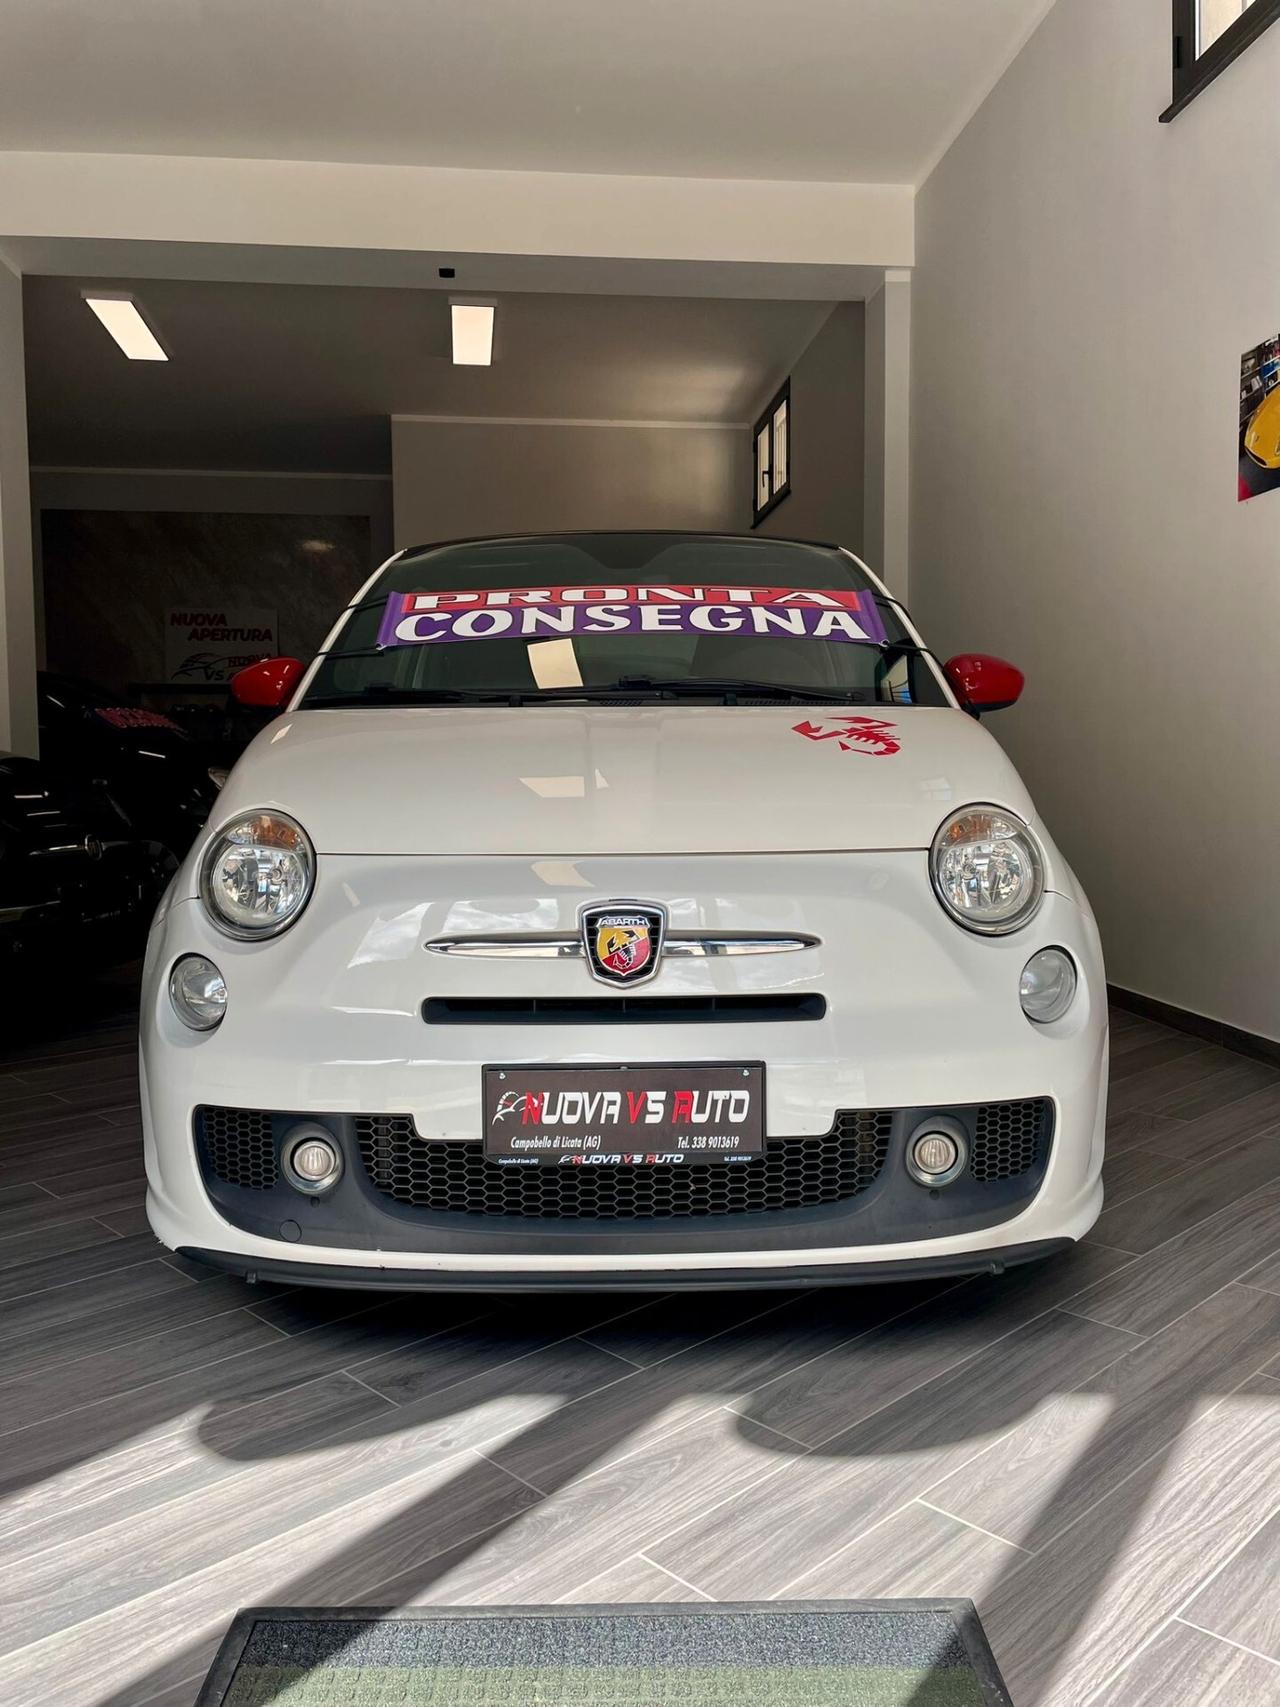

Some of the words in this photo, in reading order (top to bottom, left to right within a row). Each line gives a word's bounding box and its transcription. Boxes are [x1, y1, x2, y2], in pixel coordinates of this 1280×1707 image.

[413, 588, 845, 609] PRONTA
[171, 613, 227, 626] NUOVA
[395, 605, 870, 641] CONSEGNA
[189, 628, 272, 641] APERTURA
[522, 1091, 621, 1125] NUOVA
[626, 1091, 667, 1124] VS
[671, 1090, 750, 1124] AUTO
[510, 1136, 552, 1151] Campobello
[553, 1136, 561, 1148] di
[562, 1136, 582, 1148] Licata
[583, 1135, 601, 1150] (AG)
[677, 1137, 690, 1149] Tel.
[691, 1137, 706, 1148] 338
[708, 1136, 740, 1148] 9013619
[573, 1154, 621, 1164] NUOVA
[624, 1154, 643, 1163] VS
[645, 1154, 684, 1163] AUTO
